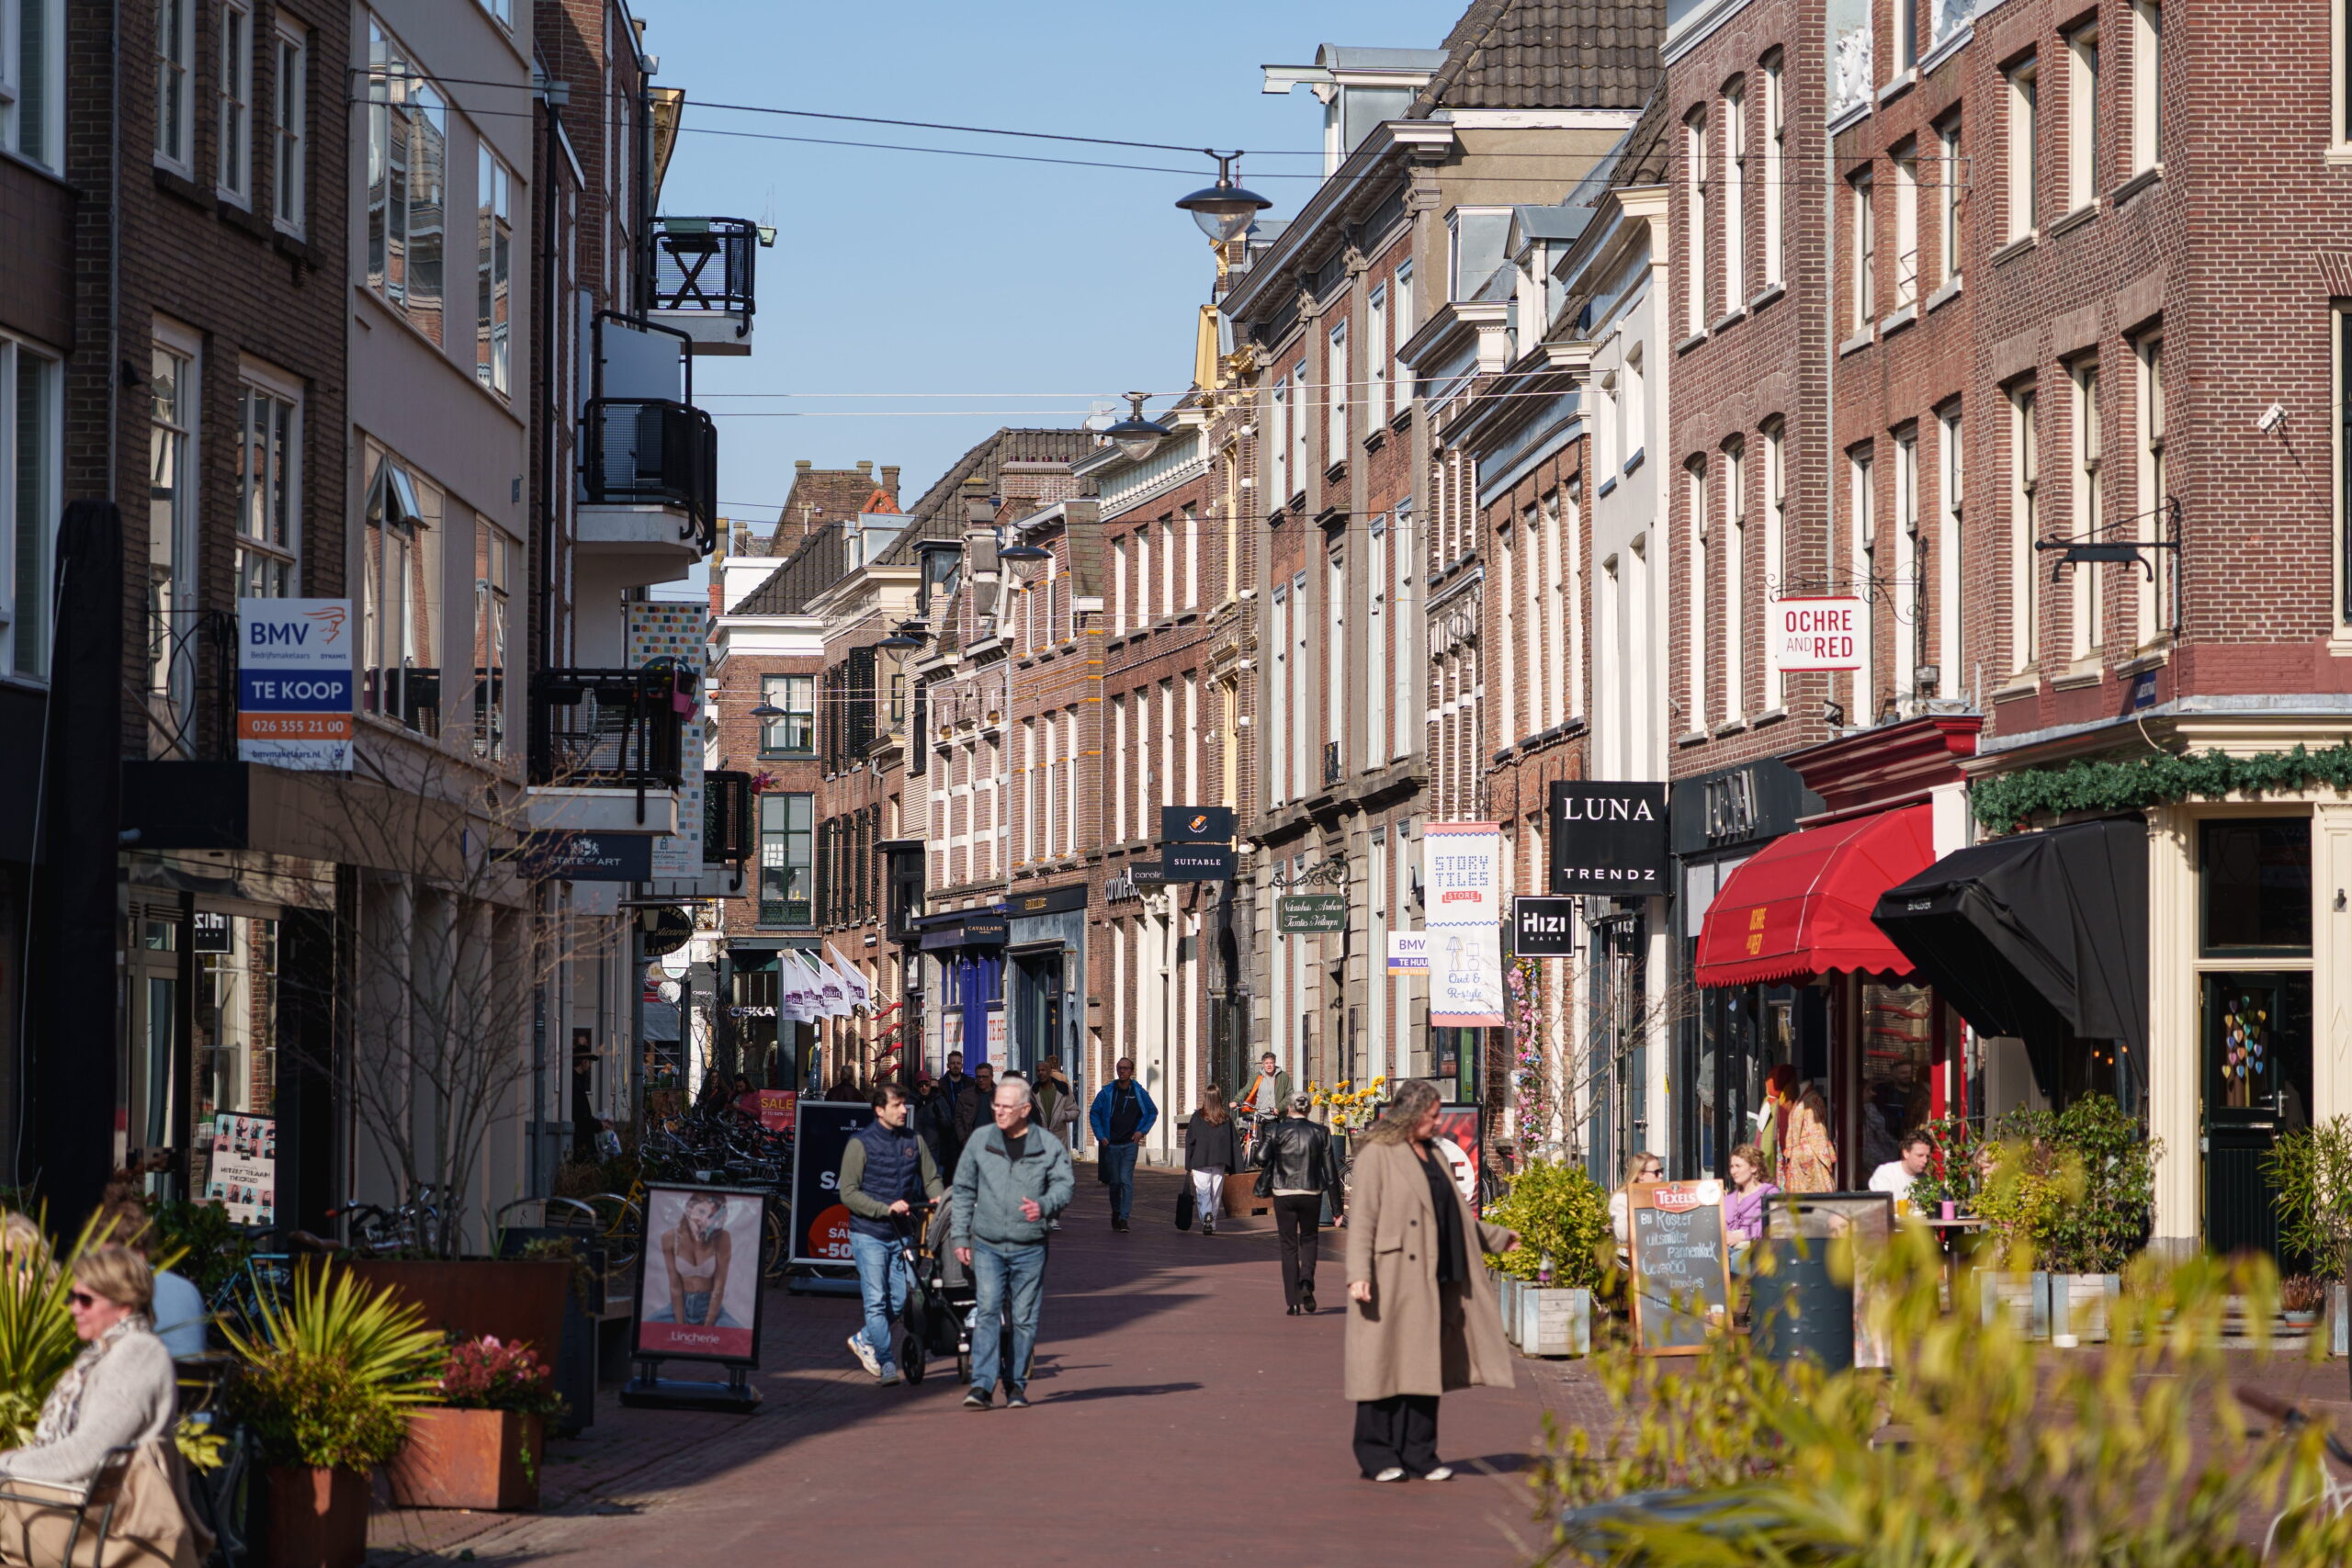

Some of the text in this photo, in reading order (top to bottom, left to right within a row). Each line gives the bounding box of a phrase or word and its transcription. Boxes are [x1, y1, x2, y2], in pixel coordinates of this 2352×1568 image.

[1785, 610, 1853, 633] OCHRE
[250, 622, 310, 646] BMV
[1786, 636, 1853, 659] AND RED
[250, 651, 311, 661] Bedrijfsmakelaars
[251, 681, 344, 700] TE KOOP
[252, 720, 344, 733] 026 355 21 00
[1563, 796, 1655, 821] LUNA
[548, 855, 586, 866] STATE
[595, 857, 622, 866] ART
[1173, 858, 1222, 866] SUITABLE
[1434, 855, 1489, 871] STORY
[1434, 872, 1489, 887] TILES
[1563, 868, 1656, 881] TRENDZ
[1447, 892, 1476, 901] STORE
[1315, 899, 1343, 912] Arnhem
[1284, 915, 1309, 928] Taxaties
[1312, 914, 1339, 931] Veilingen
[1523, 912, 1566, 932] HIZI
[1398, 939, 1427, 951] BMV
[1398, 958, 1429, 966] TE HUU
[1448, 973, 1481, 985] Oud &
[729, 1006, 776, 1017] OSKA
[761, 1097, 794, 1110] SALE
[1655, 1190, 1697, 1205] TEXELS
[837, 1220, 851, 1228] FIN
[818, 1242, 854, 1258] -50
[670, 1330, 721, 1345] Lincherie
